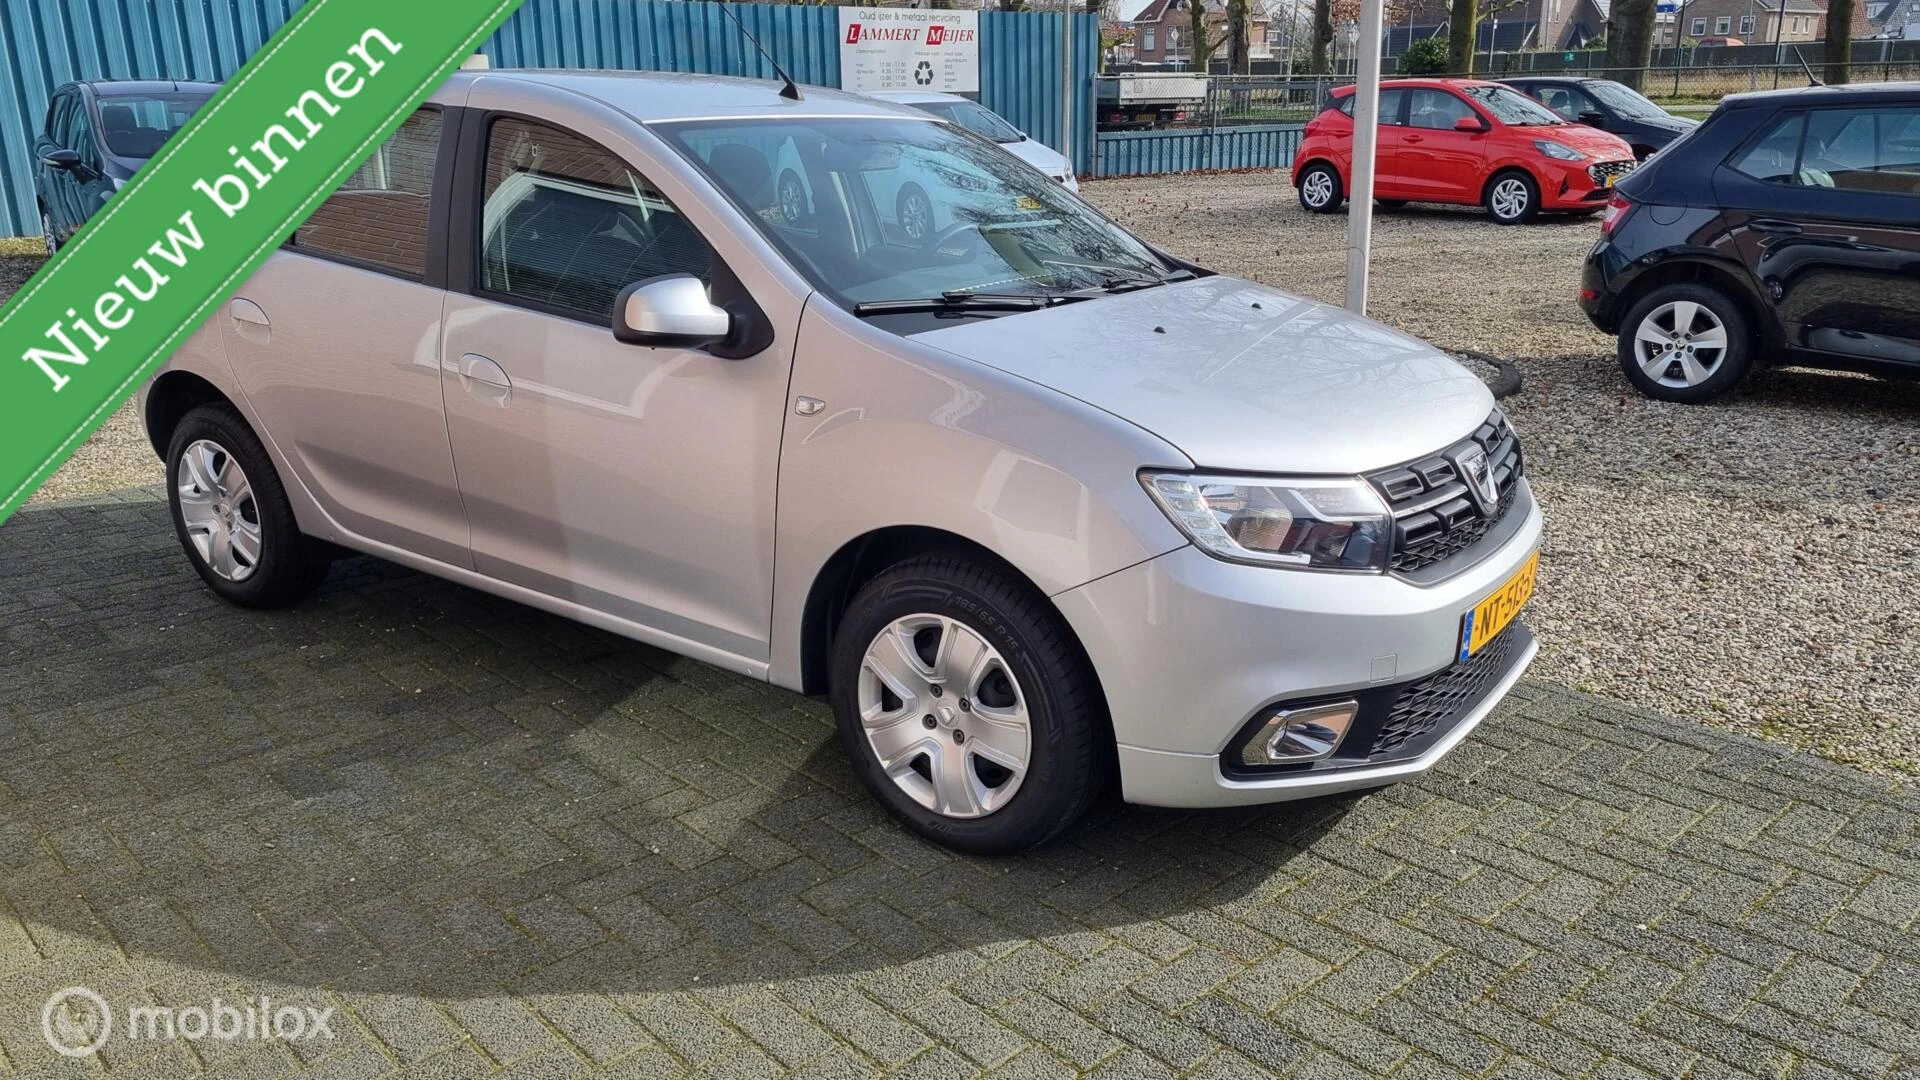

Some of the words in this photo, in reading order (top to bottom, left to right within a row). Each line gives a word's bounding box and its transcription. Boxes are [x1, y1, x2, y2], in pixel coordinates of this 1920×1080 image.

[859, 11, 876, 20] Oud
[878, 12, 892, 22] ijzer
[894, 12, 900, 21] &
[902, 12, 927, 22] metaal
[929, 13, 961, 24] recycling
[848, 26, 921, 41] LAMMERT
[927, 28, 975, 43] MEIJER
[955, 596, 996, 625] 185/65
